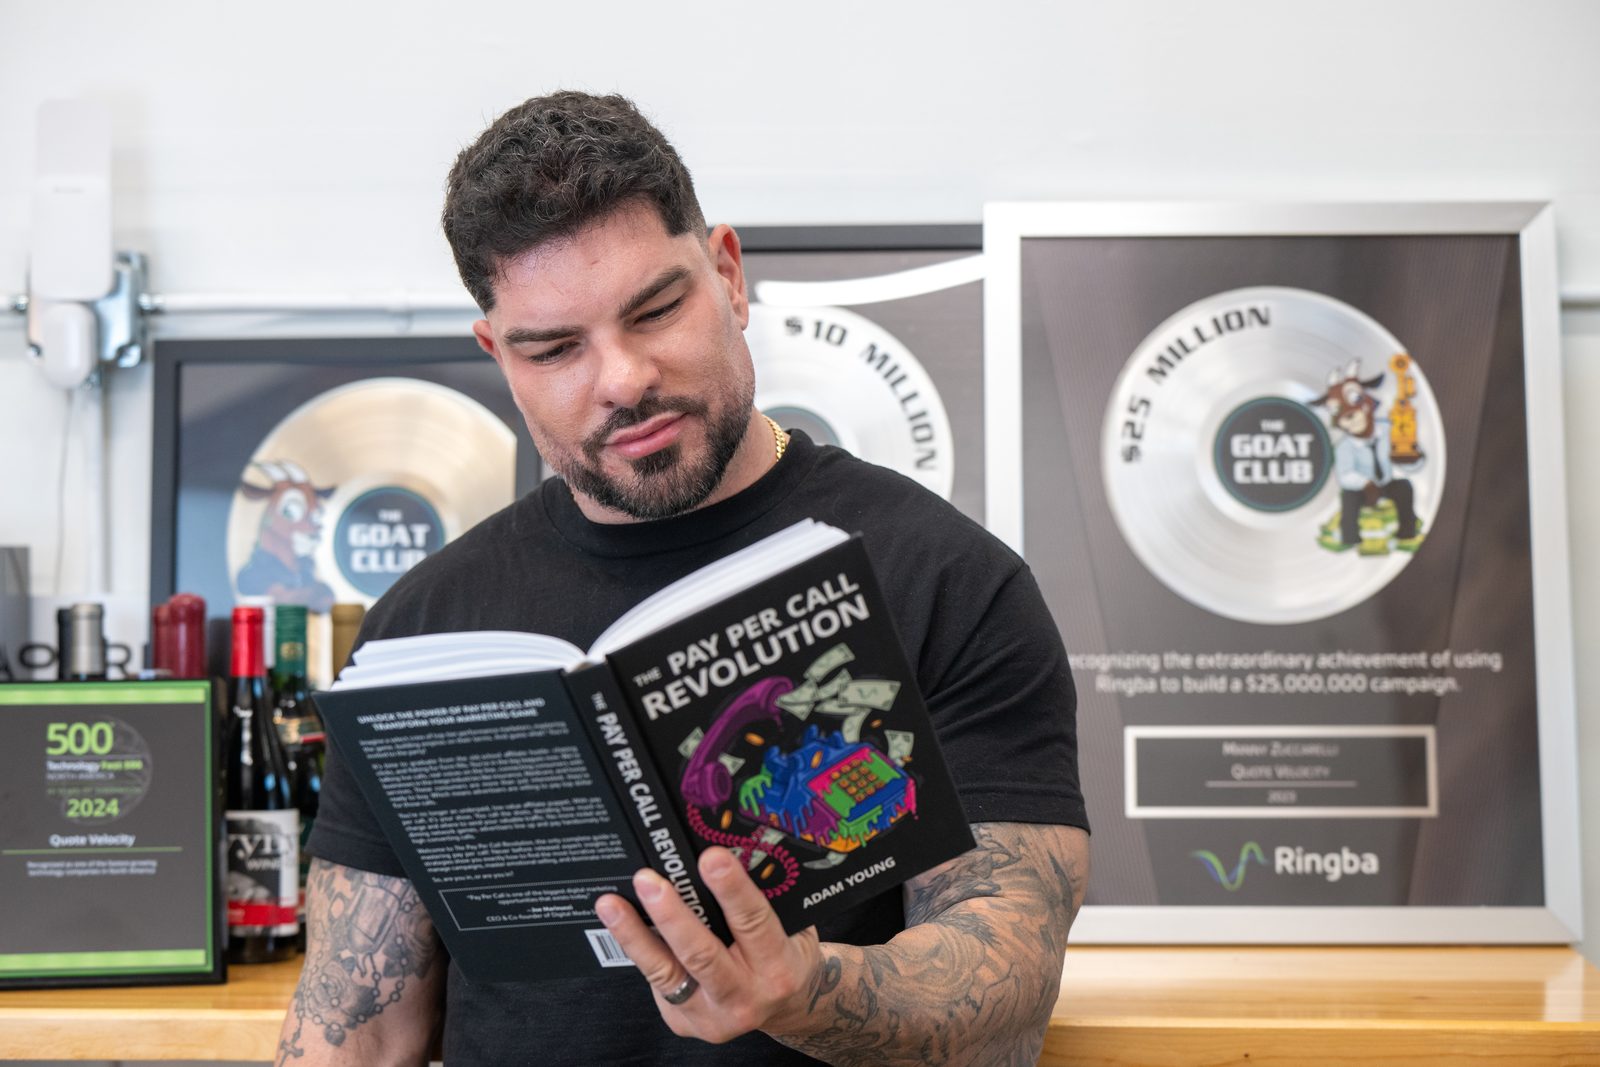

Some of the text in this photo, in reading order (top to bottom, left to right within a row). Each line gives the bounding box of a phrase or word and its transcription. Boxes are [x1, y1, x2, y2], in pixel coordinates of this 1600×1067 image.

[784, 317, 938, 470] $10 MILLION
[1121, 306, 1271, 463] $25 MILLION
[1261, 420, 1285, 432] THE
[1230, 434, 1314, 458] GOAT
[1233, 460, 1313, 485] CLUB
[347, 524, 431, 547] GOAT
[633, 573, 860, 688] THE PAY PER CALL
[641, 594, 871, 721] REVOLUTION
[1163, 651, 1192, 668] the
[1196, 651, 1313, 671] extraordinary
[1316, 651, 1427, 668] achievement
[1431, 650, 1451, 668] of
[1454, 653, 1503, 671] using
[1095, 673, 1461, 697] Ringba to build a $25,000,000 campaign.
[357, 697, 545, 724] UNLOCK THE POWER OF PAY PER CALL AND
[591, 692, 606, 711] THE
[373, 718, 428, 731] TRANSFORM
[429, 715, 454, 726] YOUR
[456, 710, 509, 723] MARKETING
[596, 711, 629, 748] PAY
[46, 722, 114, 755] 500
[612, 747, 641, 784] PER
[66, 798, 120, 817] 2024
[629, 782, 656, 828] CALL
[49, 833, 136, 848] Quote Velocity
[1274, 846, 1380, 882] Ringba
[802, 856, 897, 909] ADAM YOUNG
[486, 915, 501, 923] CEO
